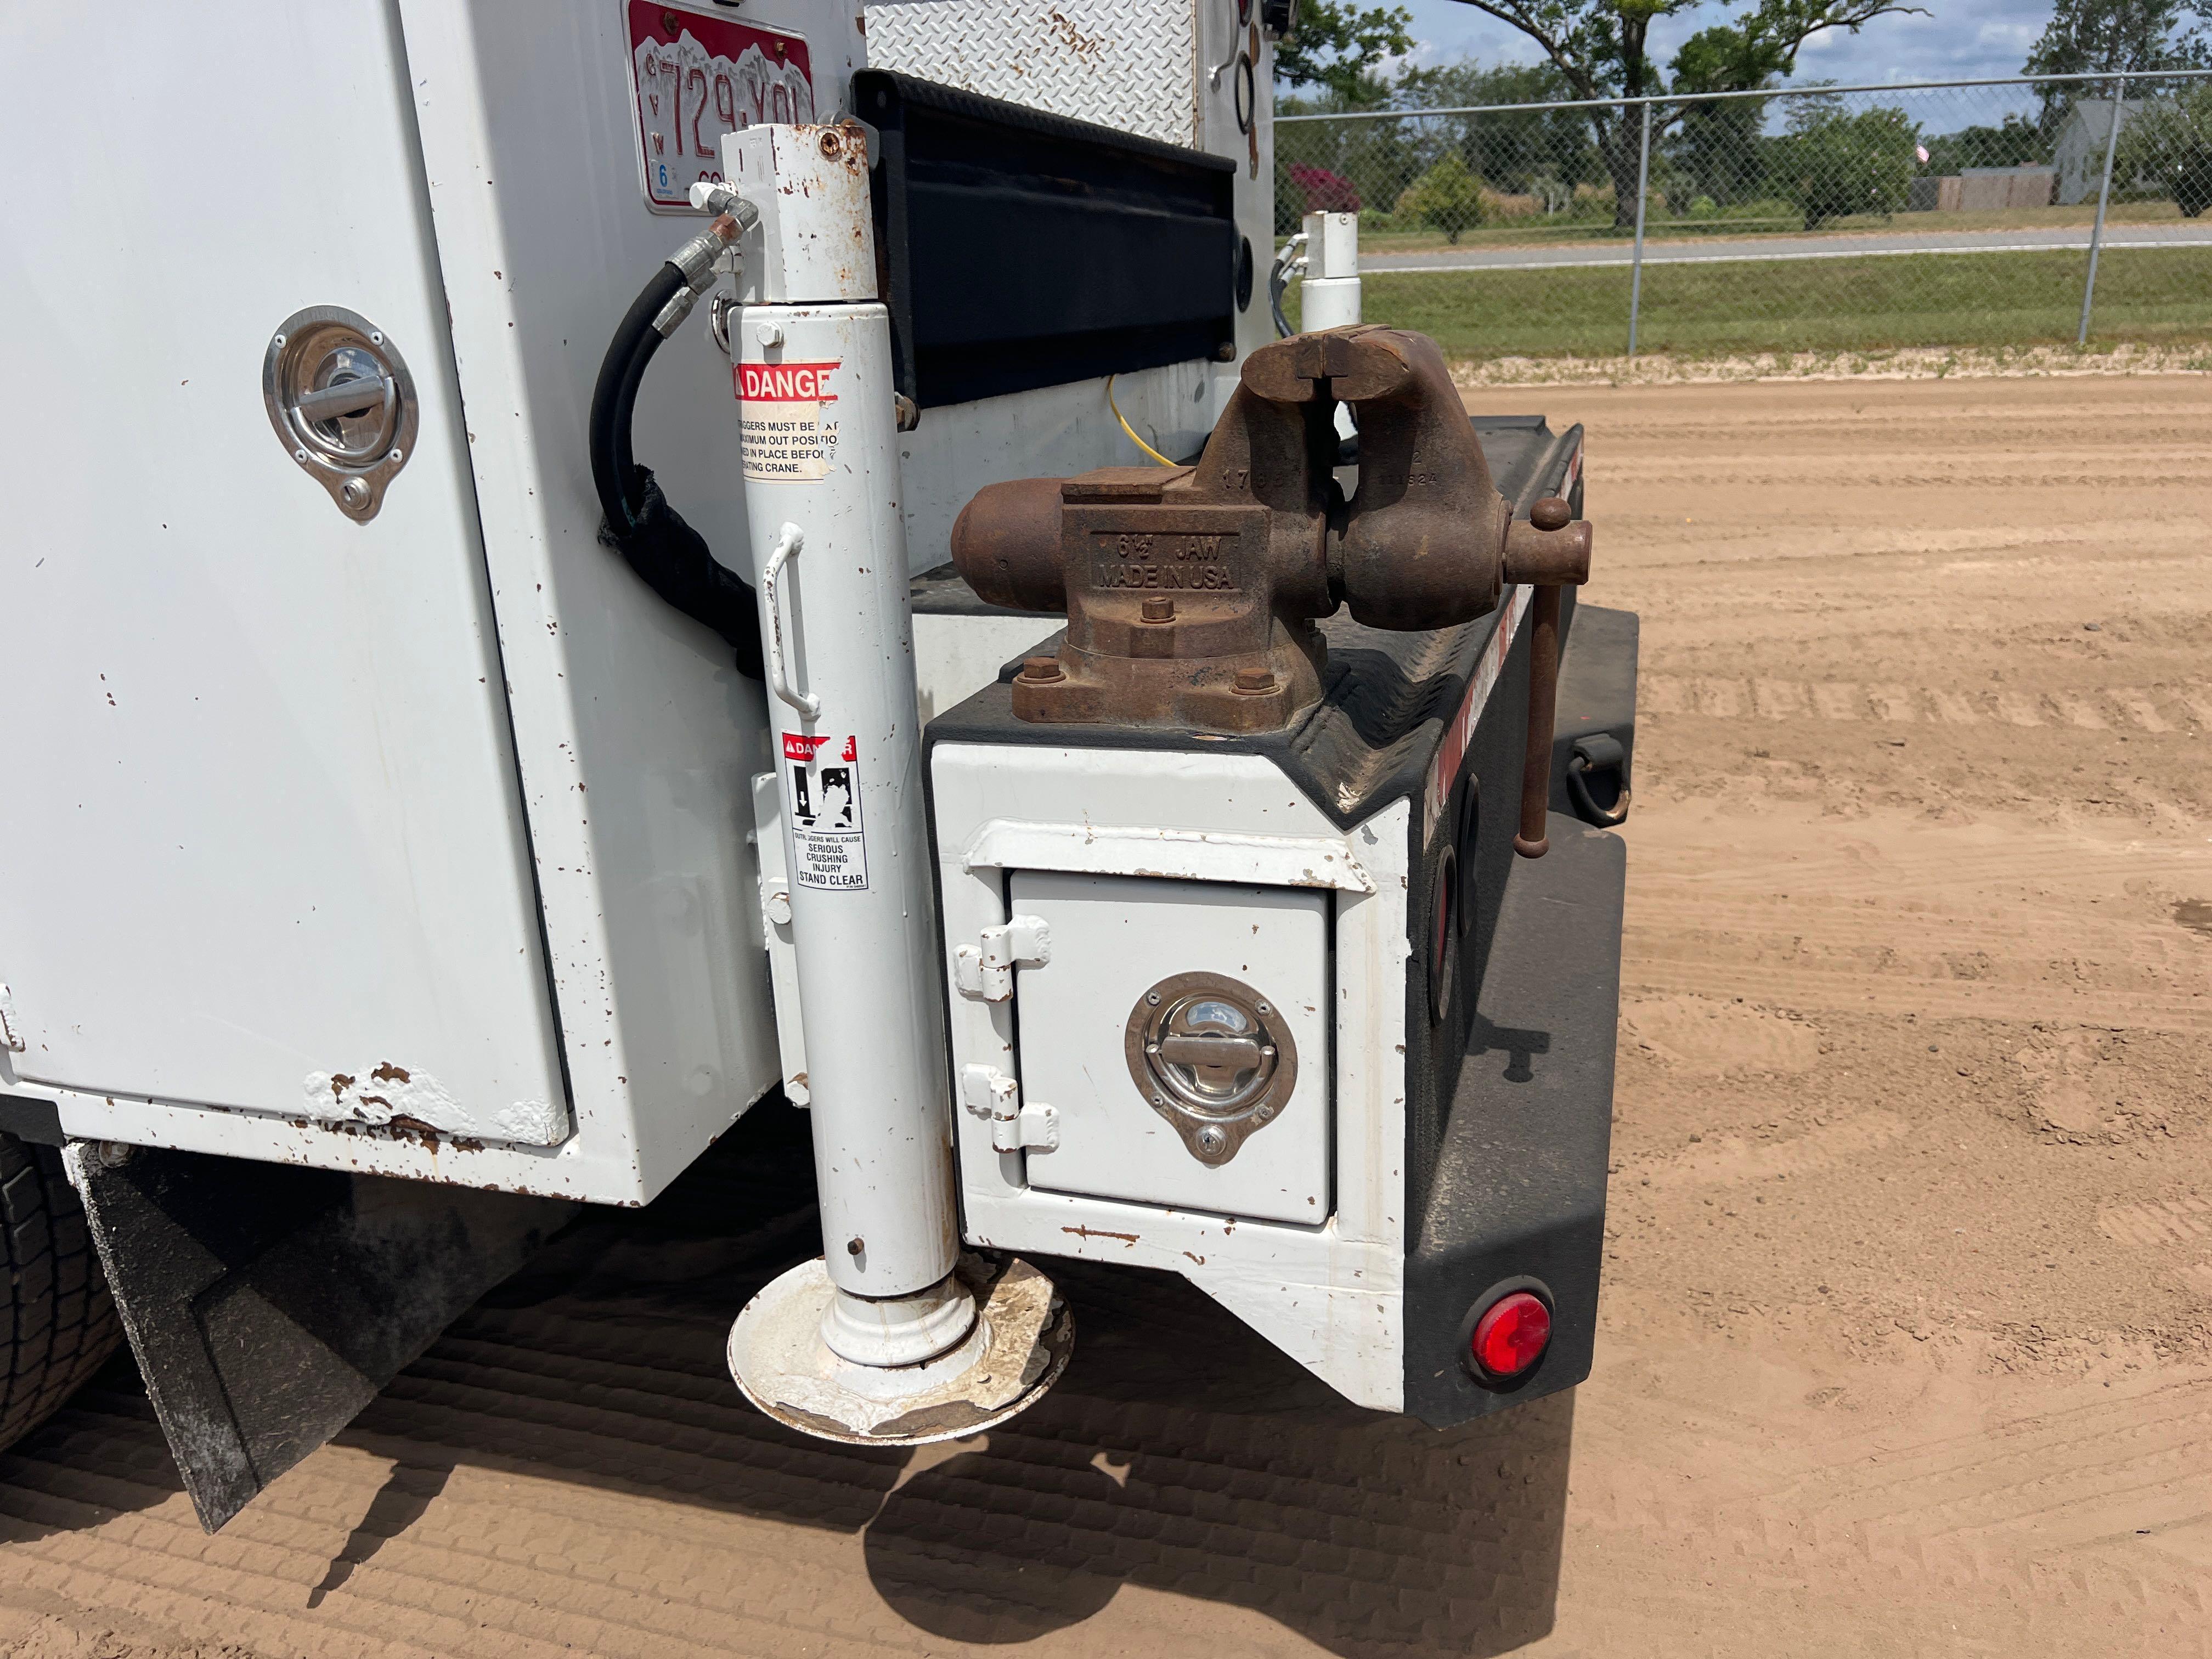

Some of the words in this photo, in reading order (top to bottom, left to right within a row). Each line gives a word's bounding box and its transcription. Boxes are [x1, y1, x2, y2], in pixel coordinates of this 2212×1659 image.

[659, 165, 668, 188] 6
[769, 422, 795, 431] MUST
[800, 422, 815, 431] BE
[769, 436, 789, 445] OUT
[750, 449, 757, 458] IN
[759, 449, 788, 459] PLACE
[765, 463, 802, 473] CRANE.
[1176, 535, 1221, 561] JAW
[1099, 564, 1158, 589] MADE
[1164, 565, 1184, 589] IN
[1189, 565, 1234, 590] USA
[808, 843, 843, 853] SERIOUS
[806, 853, 848, 863] CRUSHING
[812, 863, 842, 873] INJURY
[799, 871, 826, 884] STAND
[830, 874, 863, 885] CLEAR
